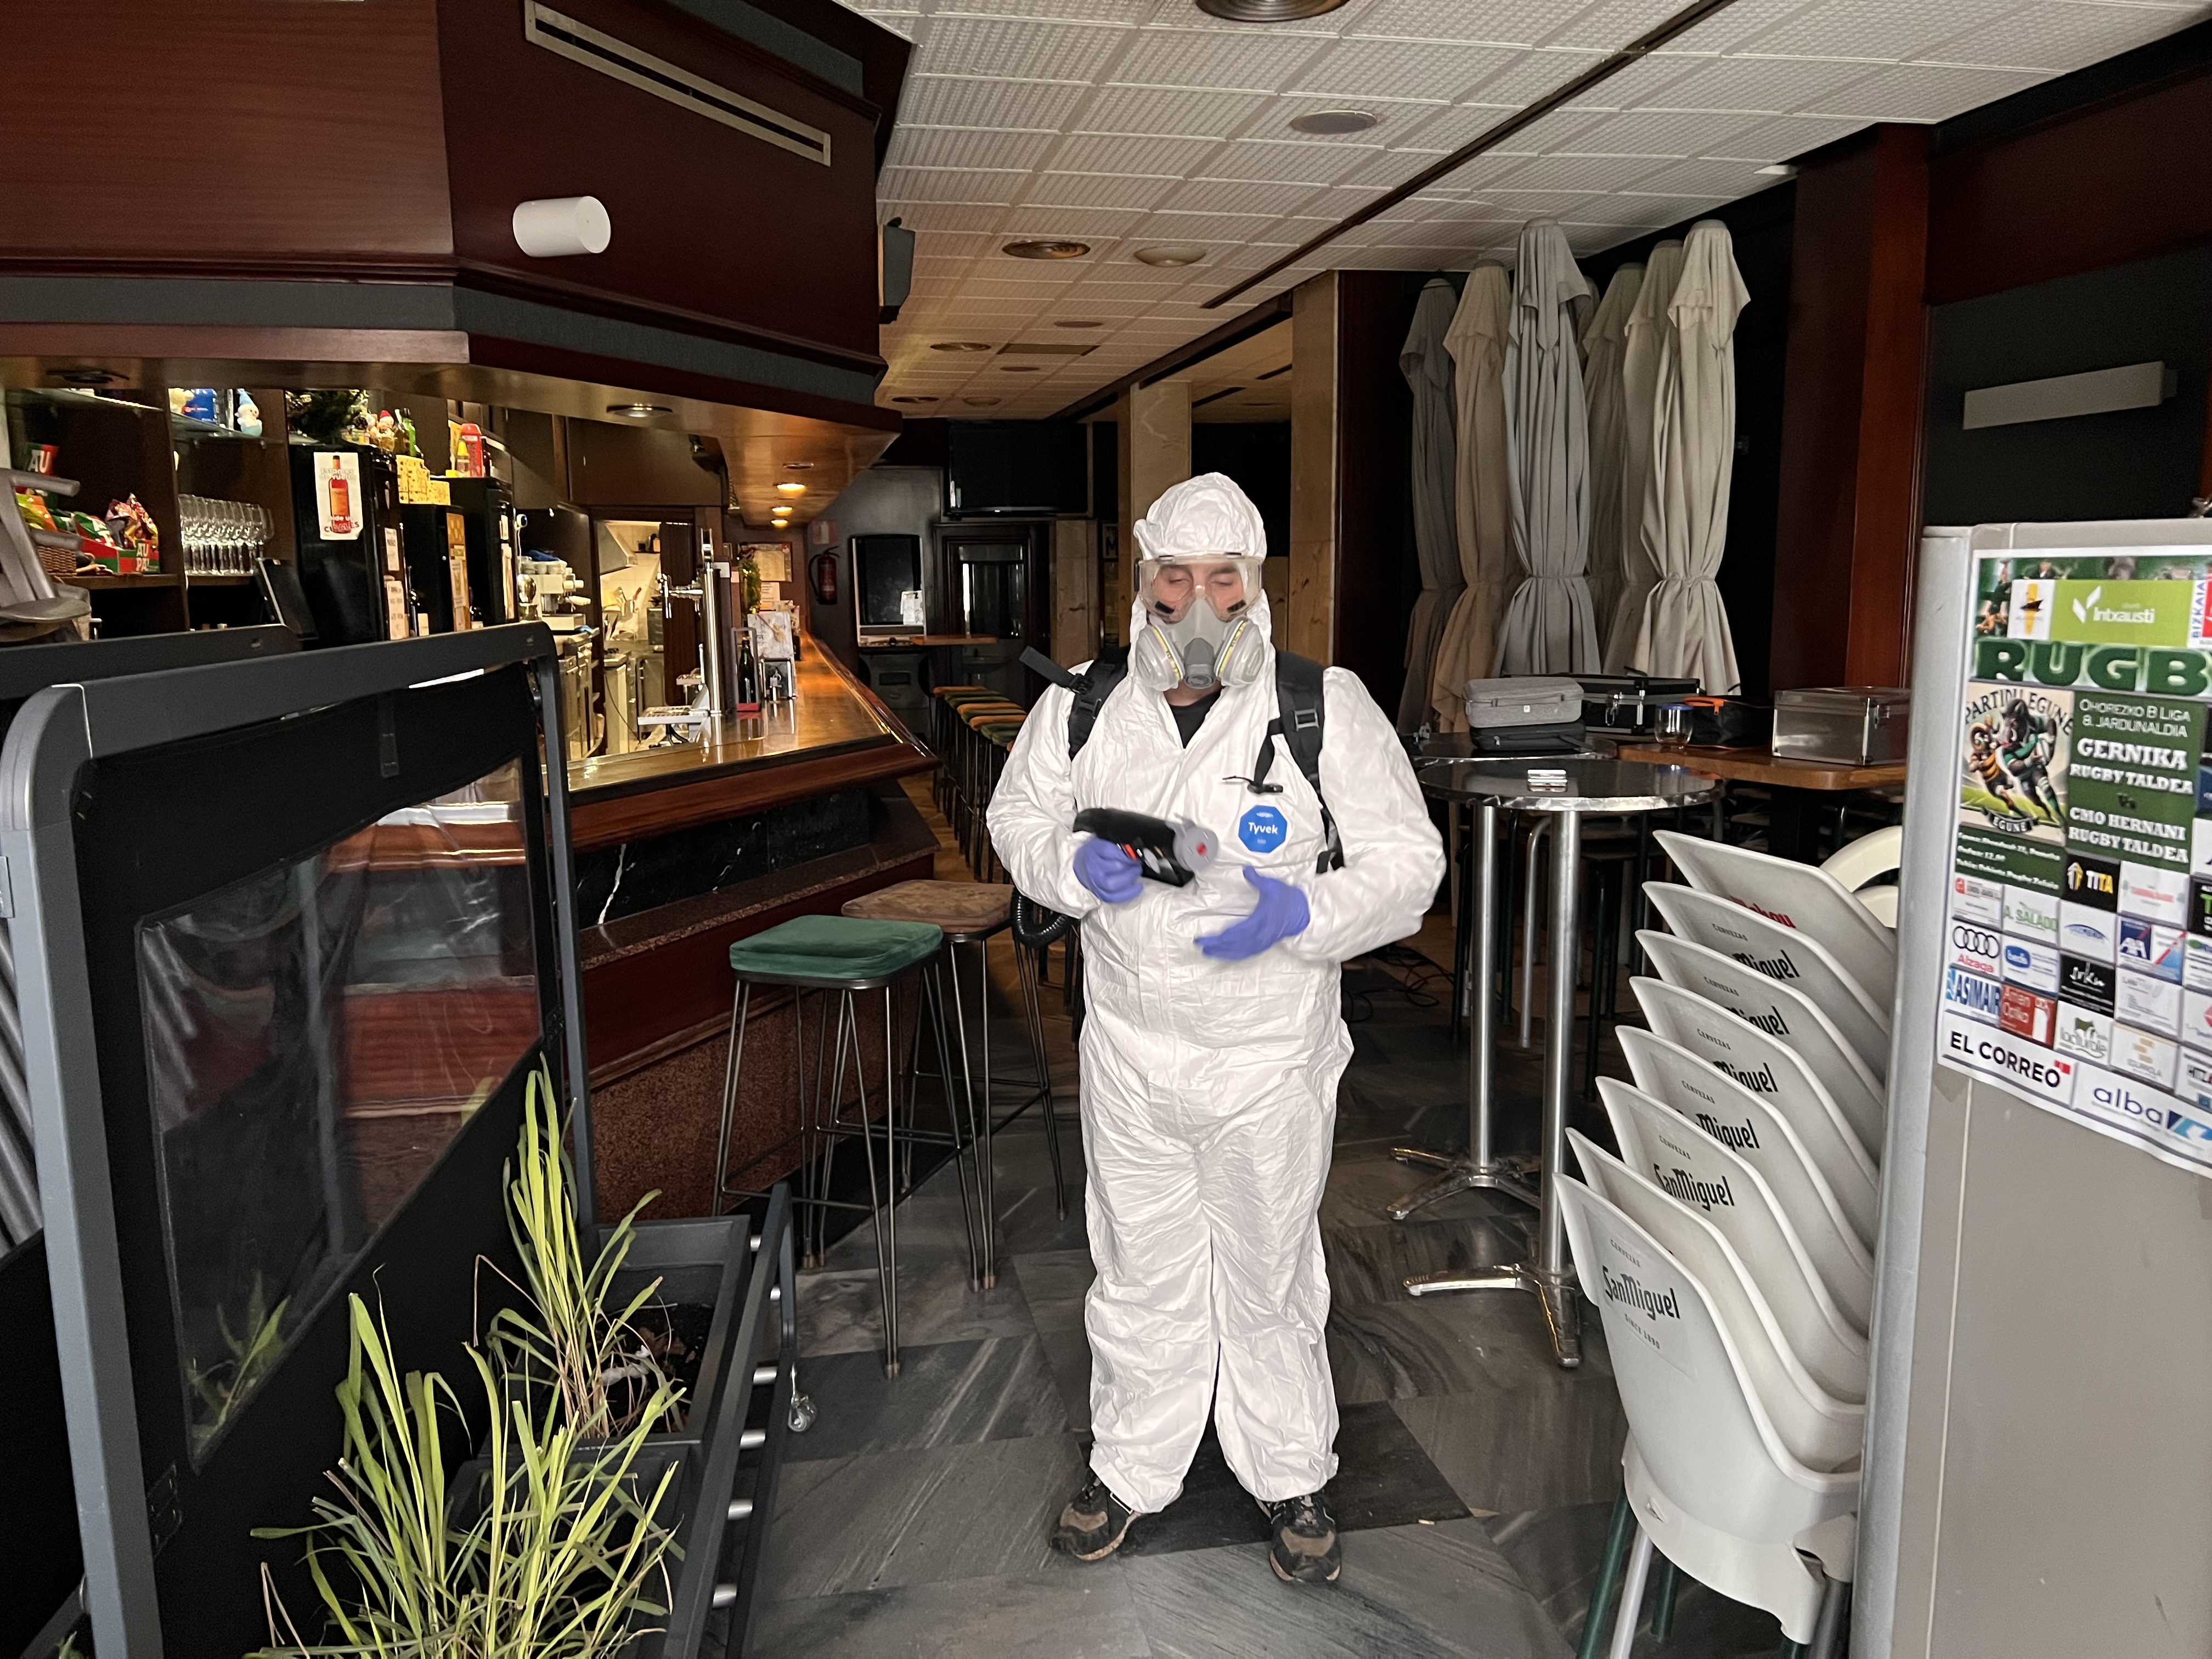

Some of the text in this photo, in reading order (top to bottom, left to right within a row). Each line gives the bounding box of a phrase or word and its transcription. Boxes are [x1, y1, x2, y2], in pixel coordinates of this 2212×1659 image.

[137, 543, 149, 557] AU
[2191, 582, 2205, 638] BIZKAIA
[1975, 640, 2212, 695] RUGB
[2096, 716, 2188, 737] JARDUNALDIA
[2146, 706, 2158, 718] B
[2159, 707, 2191, 722] LIGA
[2077, 737, 2188, 771] GERNIKA
[2069, 763, 2193, 794] RUGBY TALDEA
[1248, 822, 1278, 835] Tyvek
[2108, 814, 2186, 841] HERNANI
[2068, 826, 2190, 864] RUGBY TALDEA
[1712, 923, 1748, 941] CERVEZAS
[1704, 976, 1740, 996] CERVEZAS
[1724, 1005, 1791, 1036] uel
[1697, 1028, 1731, 1050] CERVEZAS
[1950, 1031, 2061, 1088] EL CORREO
[1681, 1080, 1716, 1104] CERVEZAS
[2093, 1086, 2163, 1125] alba
[1676, 1109, 1760, 1153] Miguel
[1658, 1135, 1691, 1160] CERVEZAS
[1610, 1238, 1641, 1268] CERVEZAS
